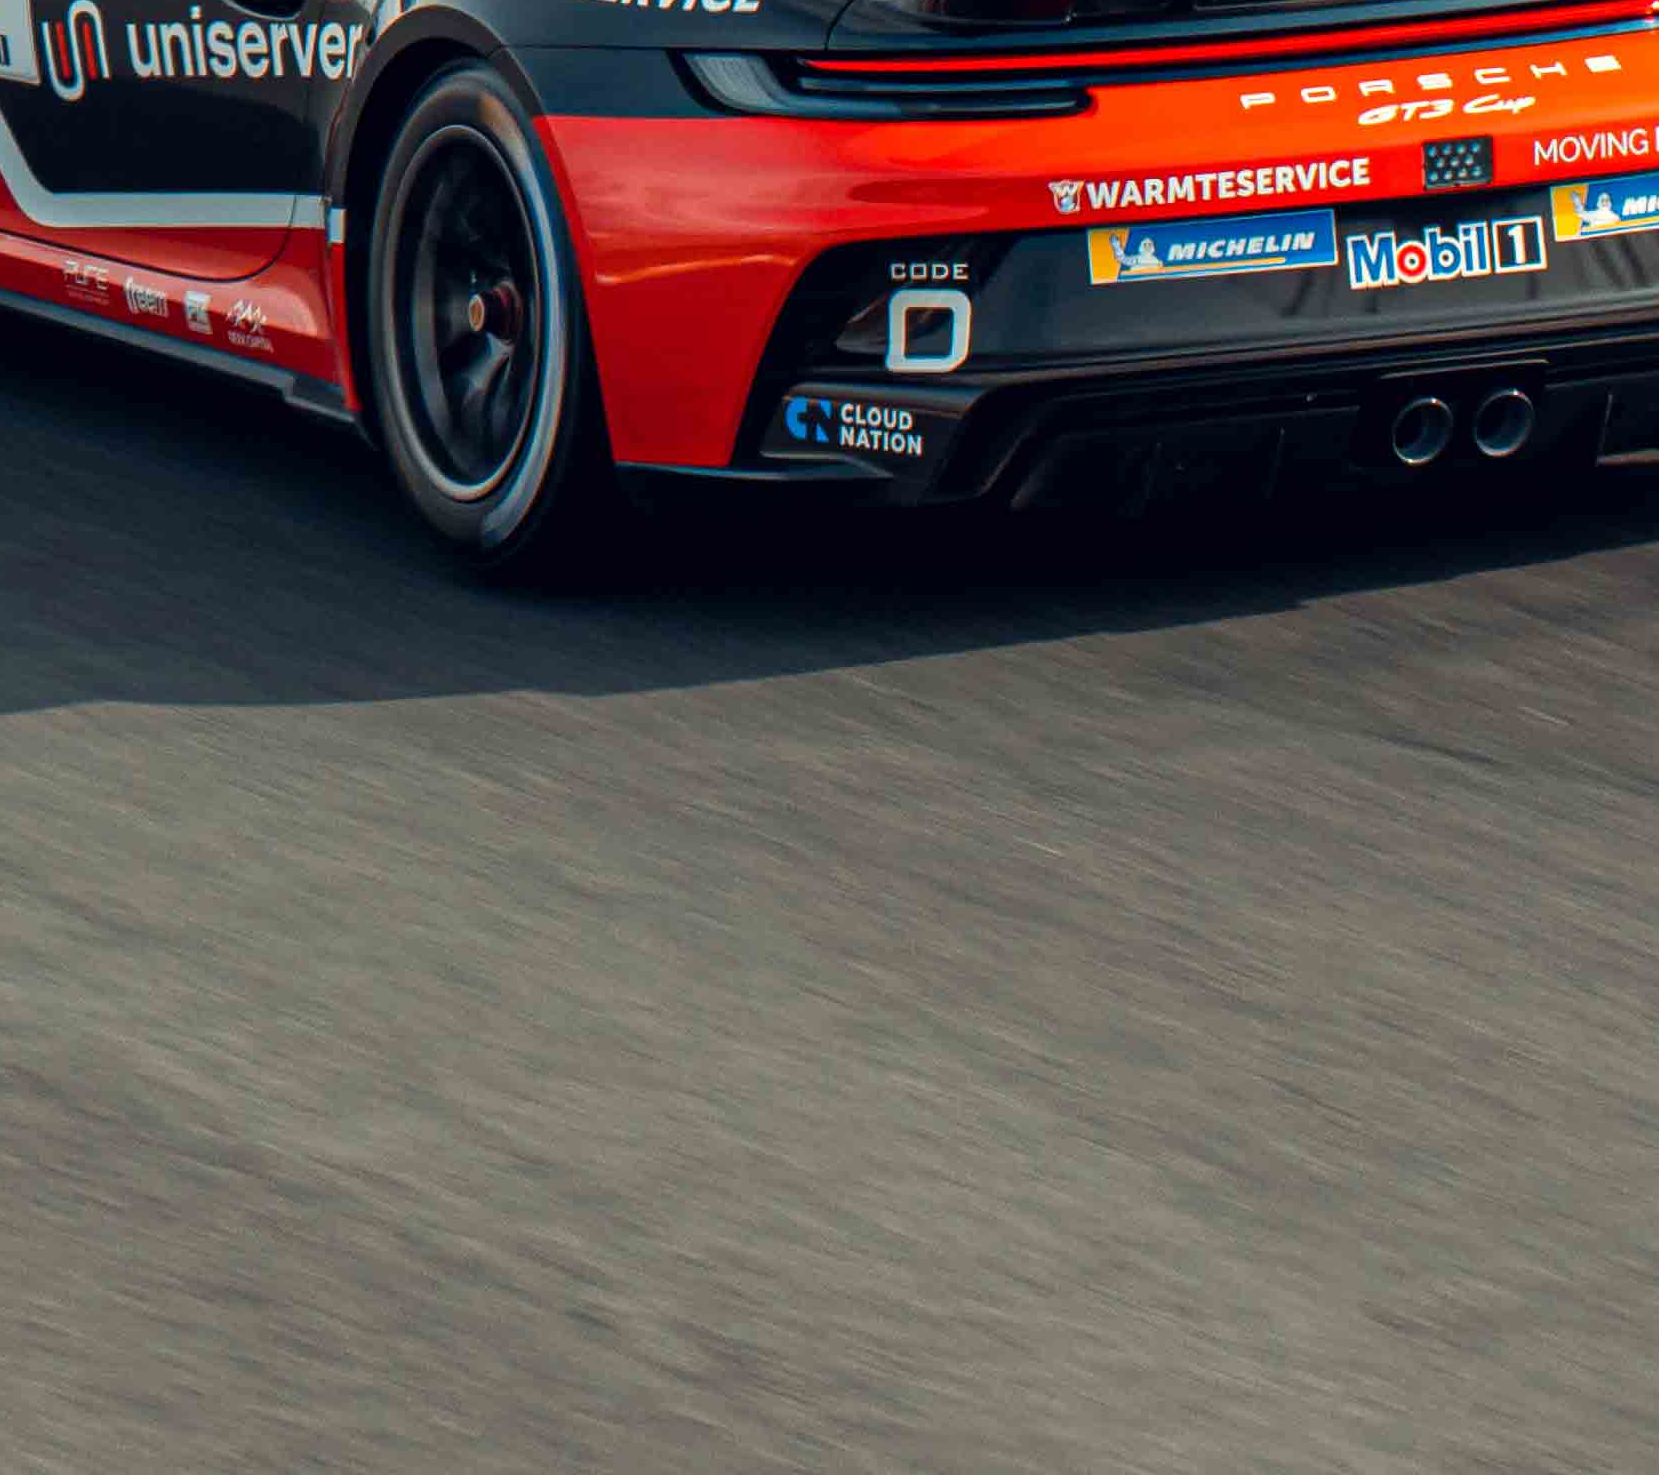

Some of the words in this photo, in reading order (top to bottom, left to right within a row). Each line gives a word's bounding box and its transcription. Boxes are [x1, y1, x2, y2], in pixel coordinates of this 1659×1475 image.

[125, 5, 363, 80] uniserver
[1239, 54, 1623, 110] PORSCHE
[1357, 97, 1454, 126] GT3
[1462, 93, 1537, 116] Cup
[1533, 128, 1649, 166] MOVING
[1085, 157, 1372, 211] WARMTESERVICE
[1166, 231, 1317, 262] MICHELIN
[1347, 222, 1491, 291] Mobil
[890, 262, 971, 282] CODE
[840, 403, 914, 431] CLOUD
[840, 427, 924, 457] NATION
